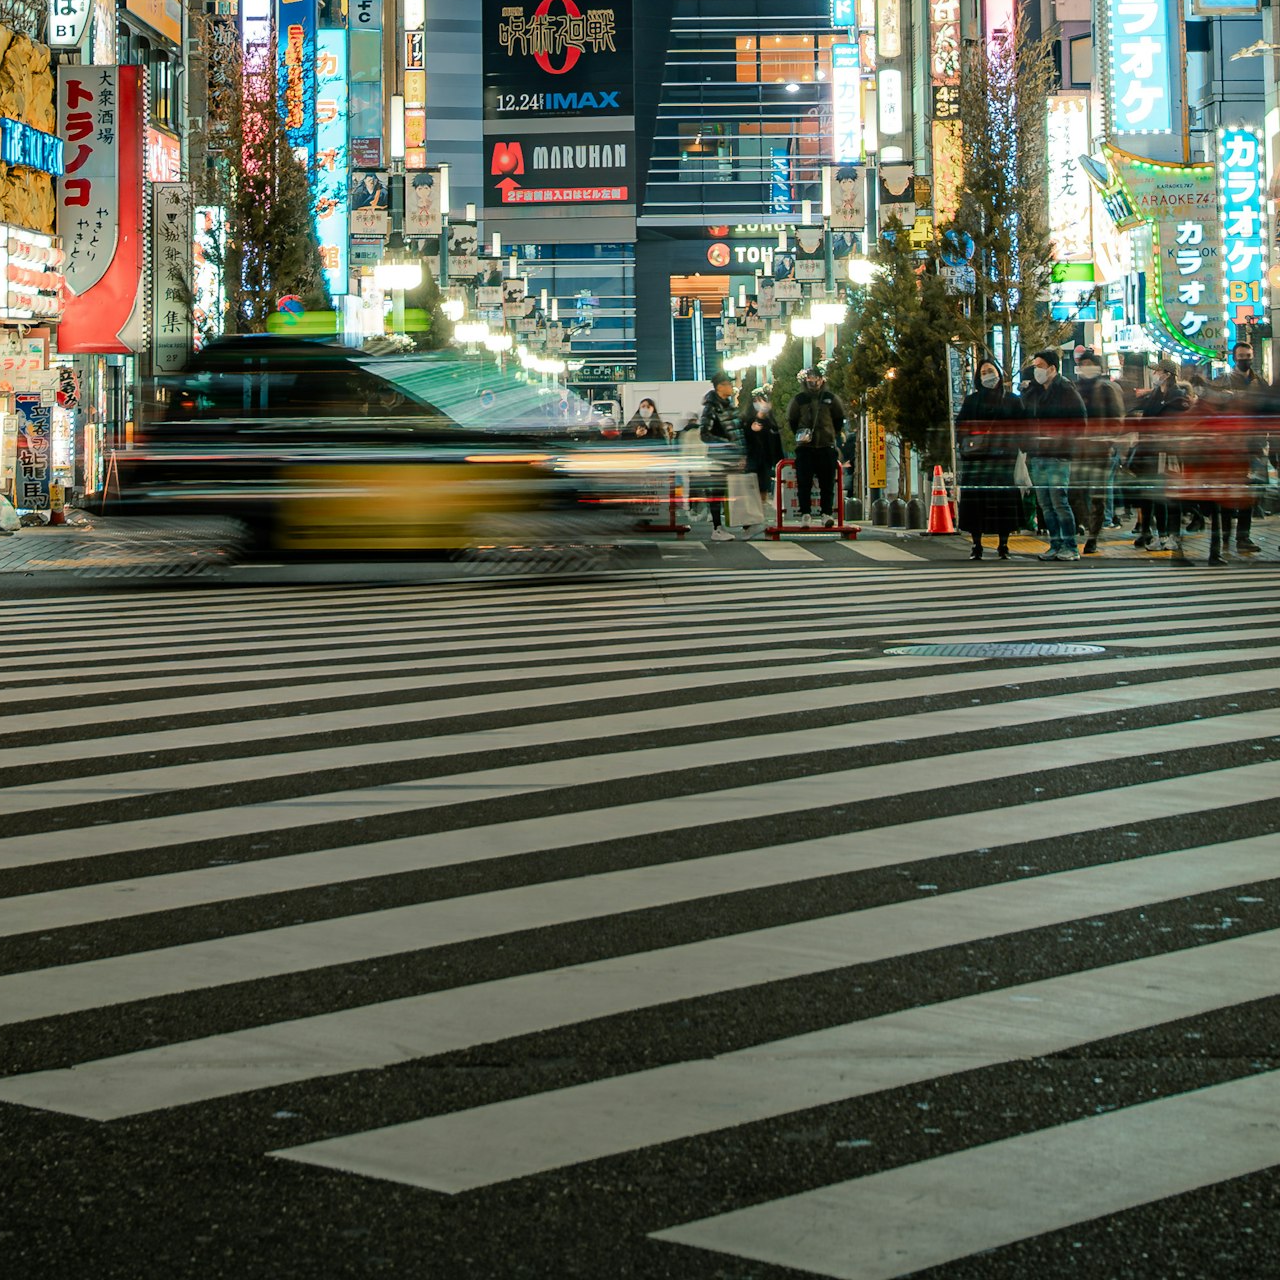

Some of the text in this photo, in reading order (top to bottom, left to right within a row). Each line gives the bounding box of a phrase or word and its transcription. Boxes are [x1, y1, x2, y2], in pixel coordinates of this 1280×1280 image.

[56, 24, 76, 37] B1
[499, 13, 617, 57] 呪術廻戦
[97, 70, 114, 145] 大衆酒場
[496, 91, 620, 112] 12.24 IMAX
[64, 79, 94, 207] トラノコ
[532, 144, 627, 170] MARUHAN
[1225, 135, 1263, 273] カラオケ
[66, 218, 90, 274] やきとん
[86, 207, 109, 262] やきとり
[1176, 220, 1208, 337] カラオケ
[1229, 280, 1259, 303] B1
[161, 309, 184, 334] 集
[166, 353, 178, 363] 2F
